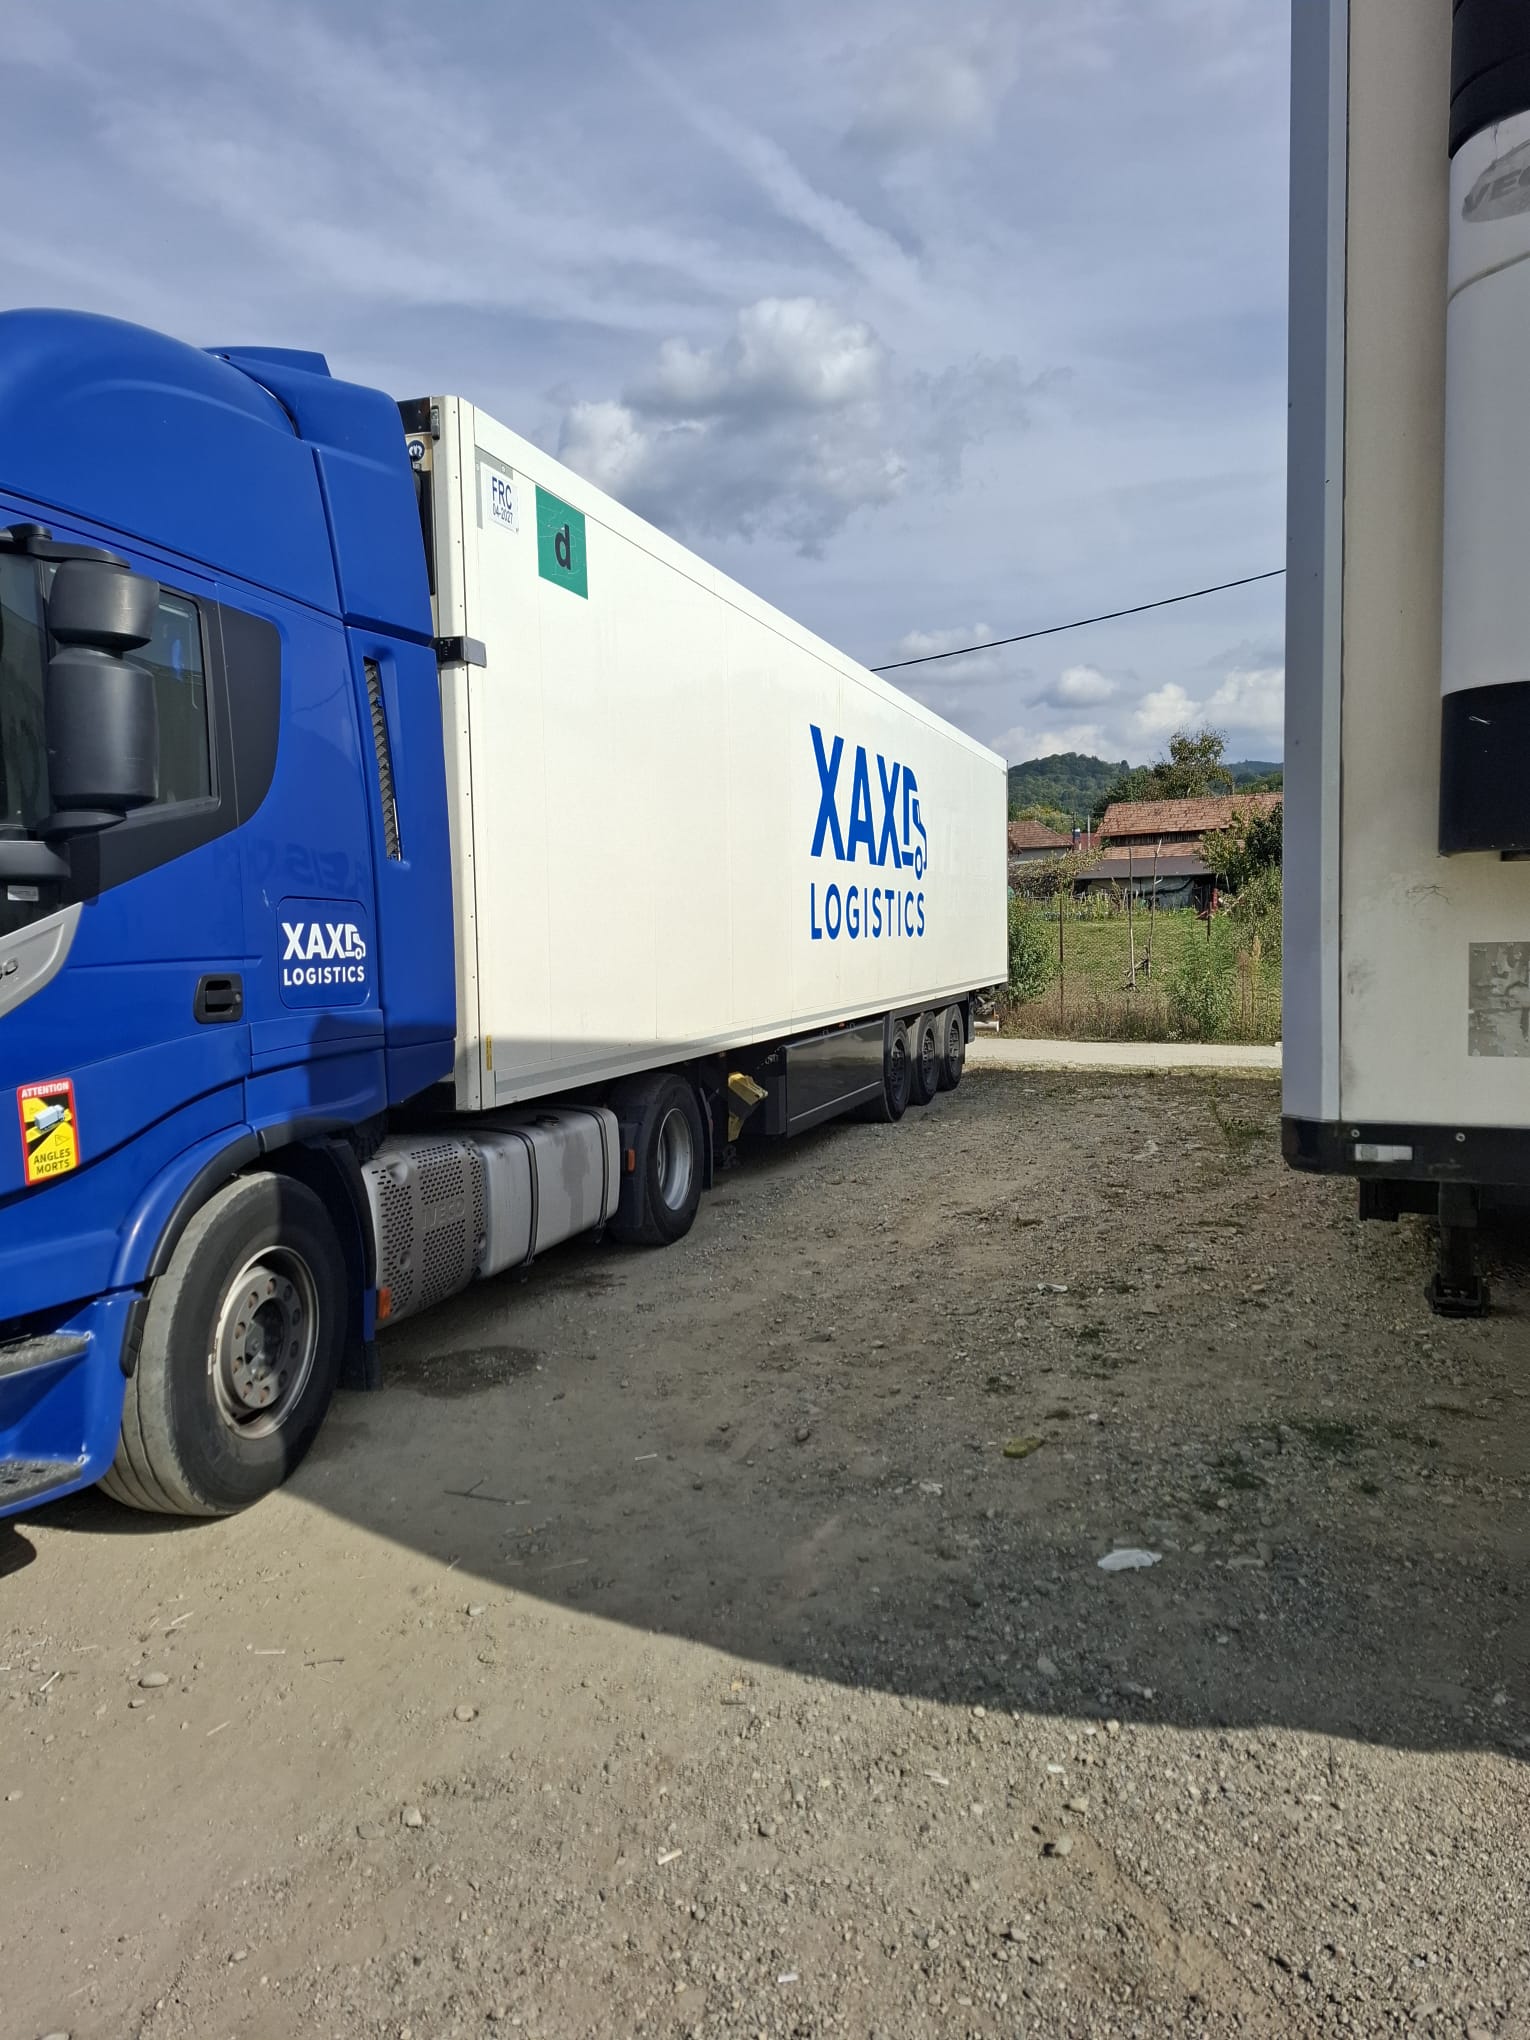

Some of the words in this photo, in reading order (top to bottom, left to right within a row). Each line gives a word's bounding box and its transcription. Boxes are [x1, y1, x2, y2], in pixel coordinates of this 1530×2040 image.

[492, 476, 512, 510] FRC
[555, 524, 571, 570] d
[810, 883, 925, 939] LOGISTICS
[283, 966, 365, 986] LOGISTICS
[21, 1081, 69, 1098] ATTENTION
[33, 1148, 70, 1165] ANGLES
[36, 1159, 70, 1175] MORTS
